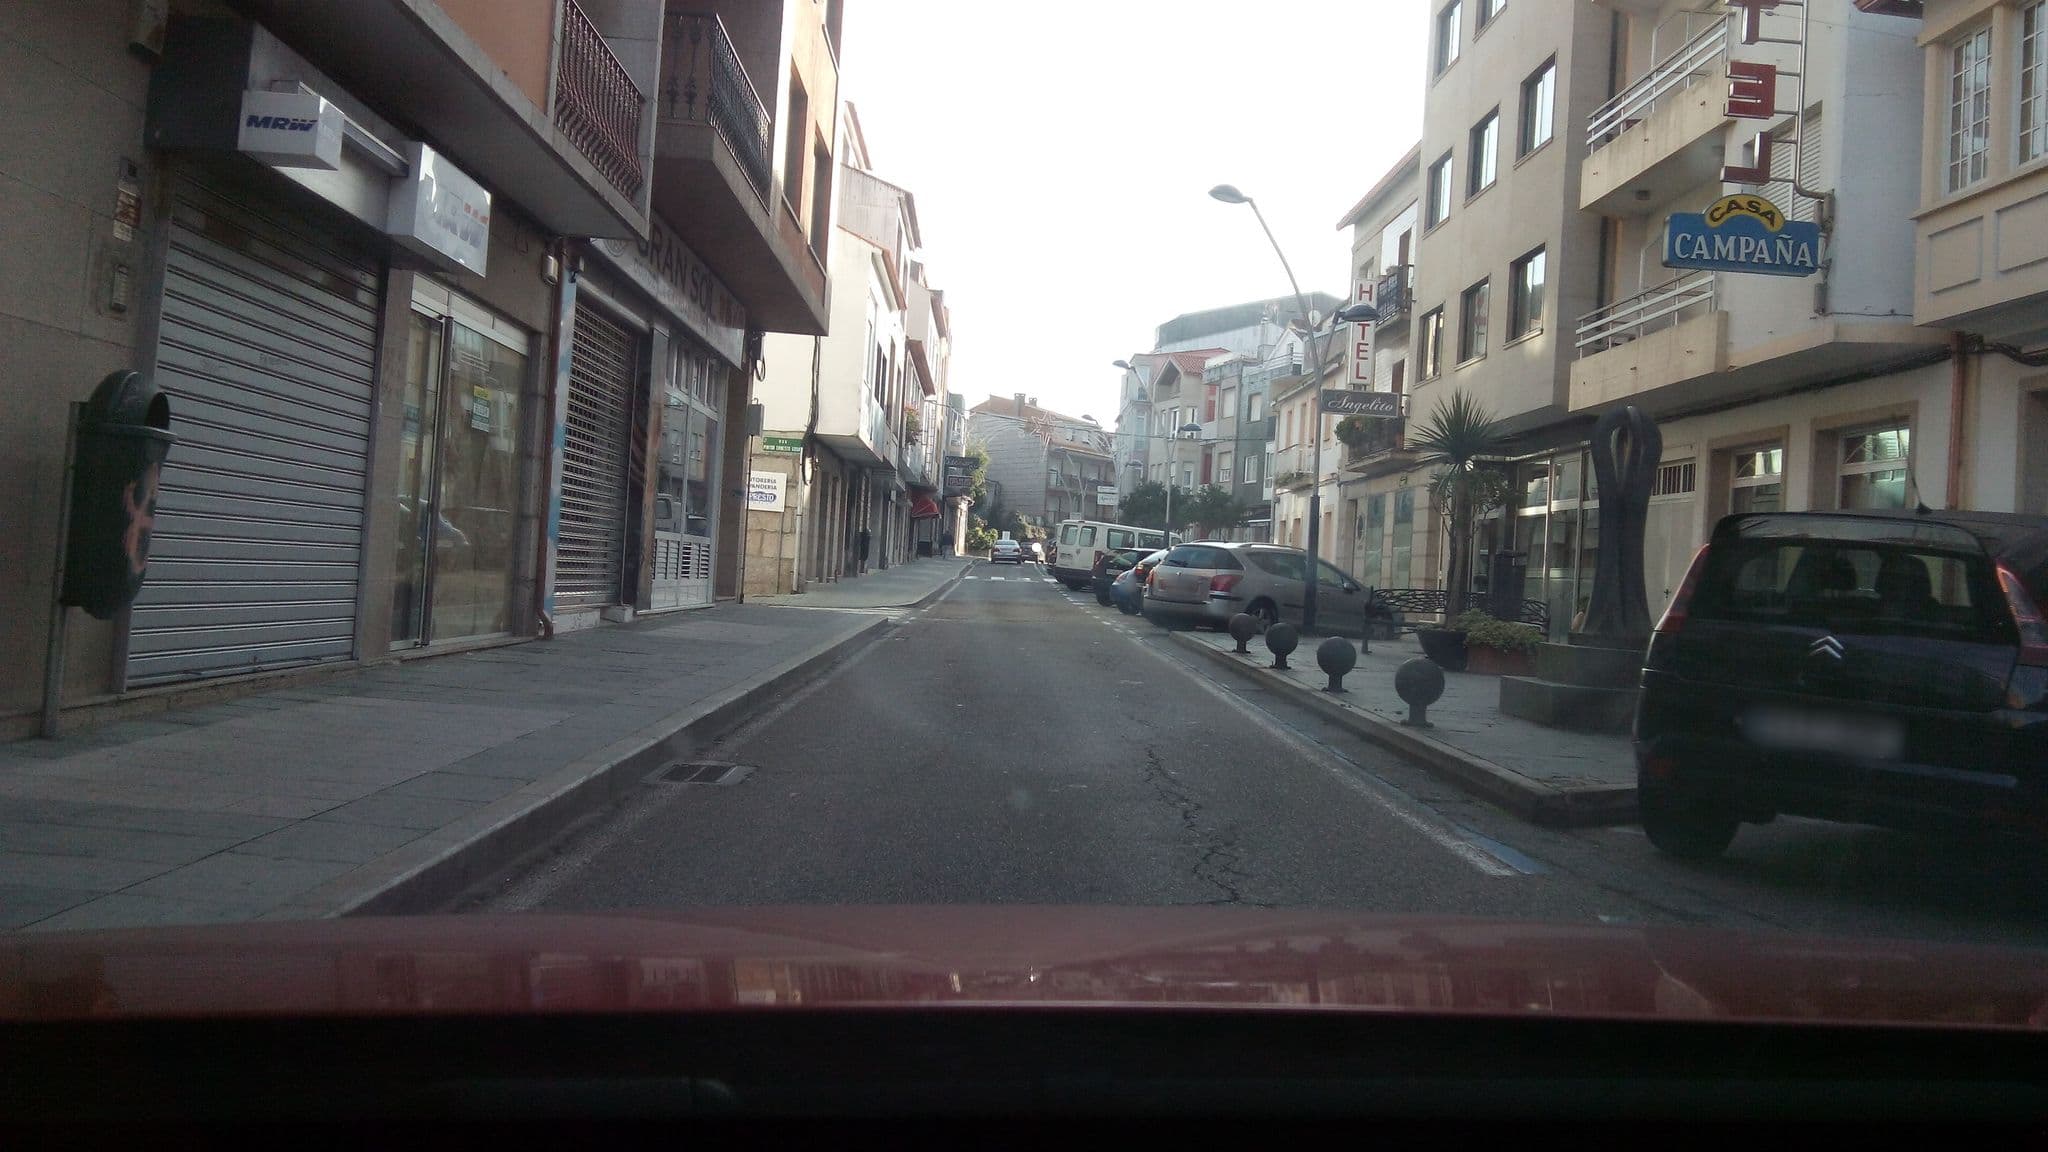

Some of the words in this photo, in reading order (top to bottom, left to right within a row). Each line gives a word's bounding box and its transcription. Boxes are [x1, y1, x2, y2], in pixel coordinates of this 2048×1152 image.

[246, 114, 318, 132] MRW
[1708, 199, 1777, 229] CASA
[1674, 233, 1816, 269] CAMPAÑA
[1355, 283, 1374, 380] HTEL
[1328, 394, 1393, 413] Angelito
